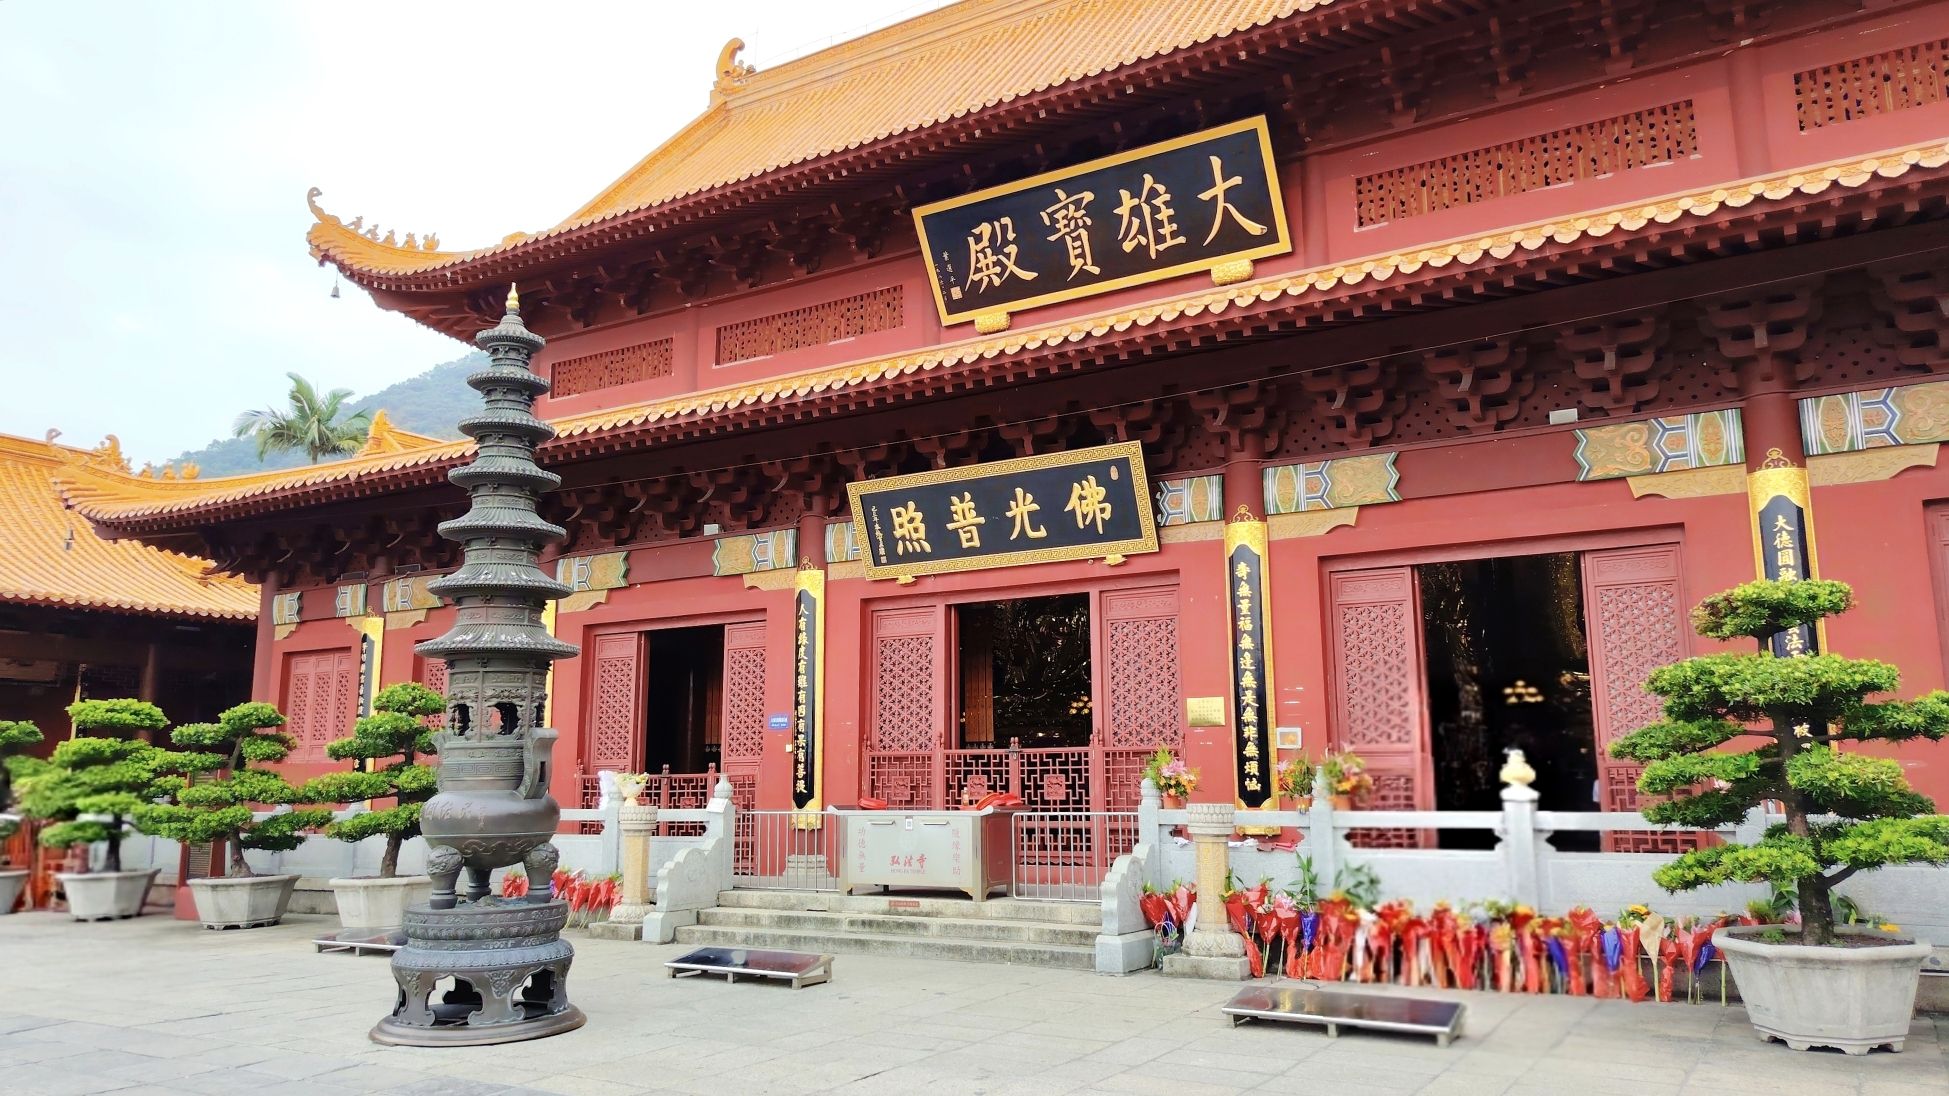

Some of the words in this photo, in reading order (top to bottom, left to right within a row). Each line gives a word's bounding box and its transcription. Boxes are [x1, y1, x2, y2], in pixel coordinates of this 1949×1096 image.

[965, 155, 1267, 294] 大雄寶殿
[890, 475, 1112, 556] 佛光普照
[889, 853, 927, 868] 弘法寺
